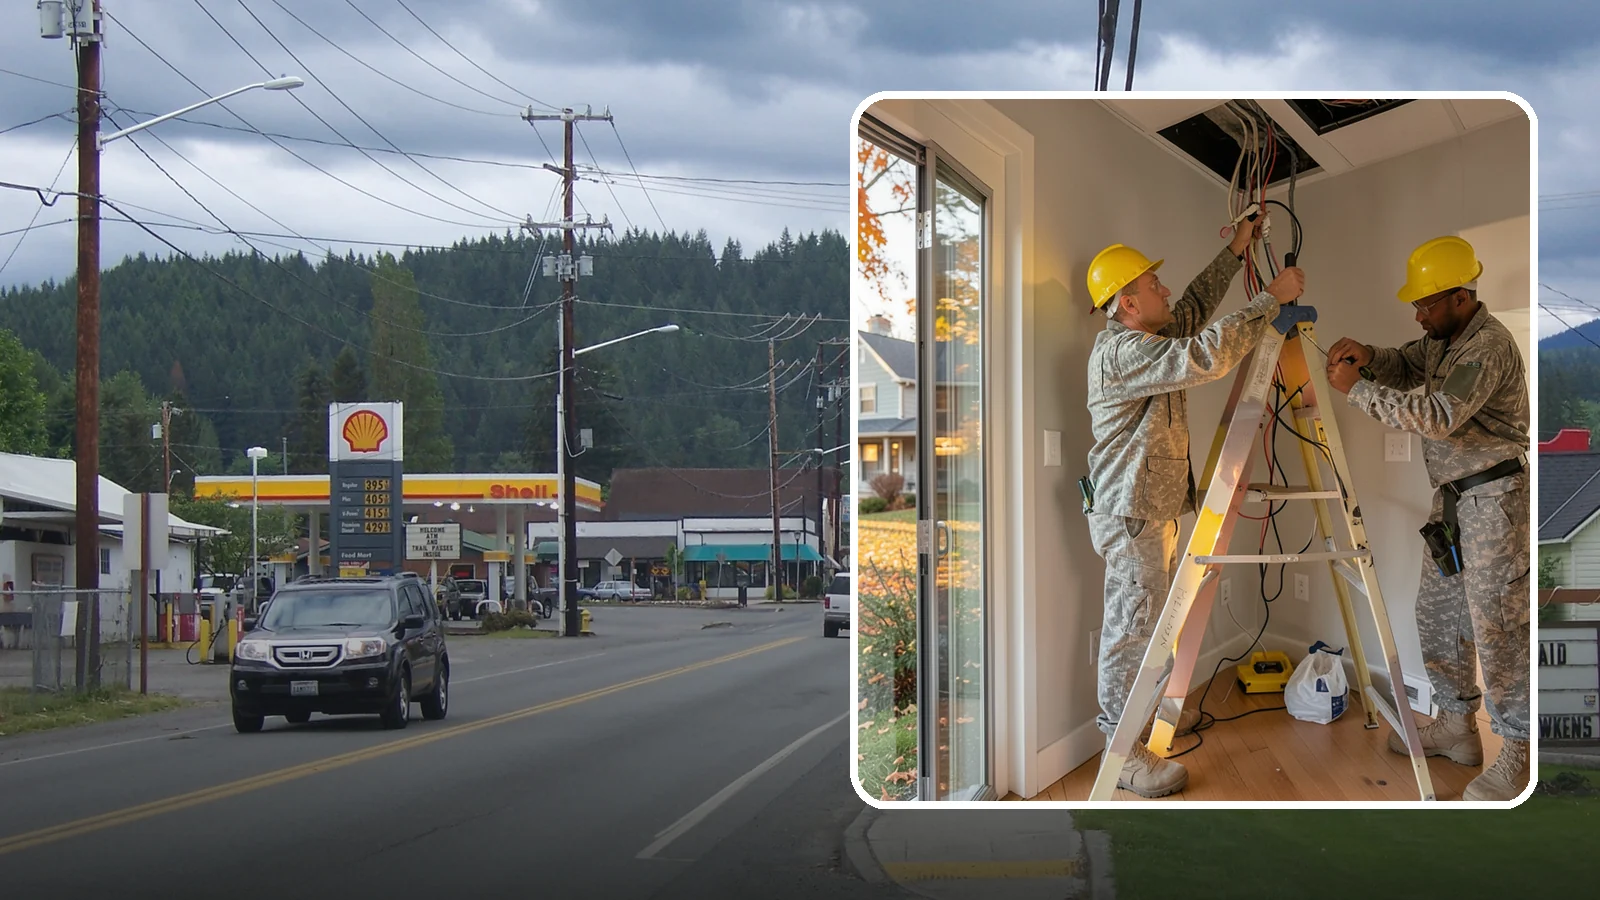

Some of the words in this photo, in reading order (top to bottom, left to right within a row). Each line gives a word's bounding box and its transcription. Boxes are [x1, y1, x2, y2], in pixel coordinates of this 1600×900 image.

[366, 480, 383, 490] 395
[490, 484, 547, 499] Shell
[366, 494, 383, 504] 405
[366, 508, 383, 518] 415
[366, 522, 383, 532] 429
[1538, 642, 1567, 665] AID
[1538, 716, 1592, 739] WKENS
